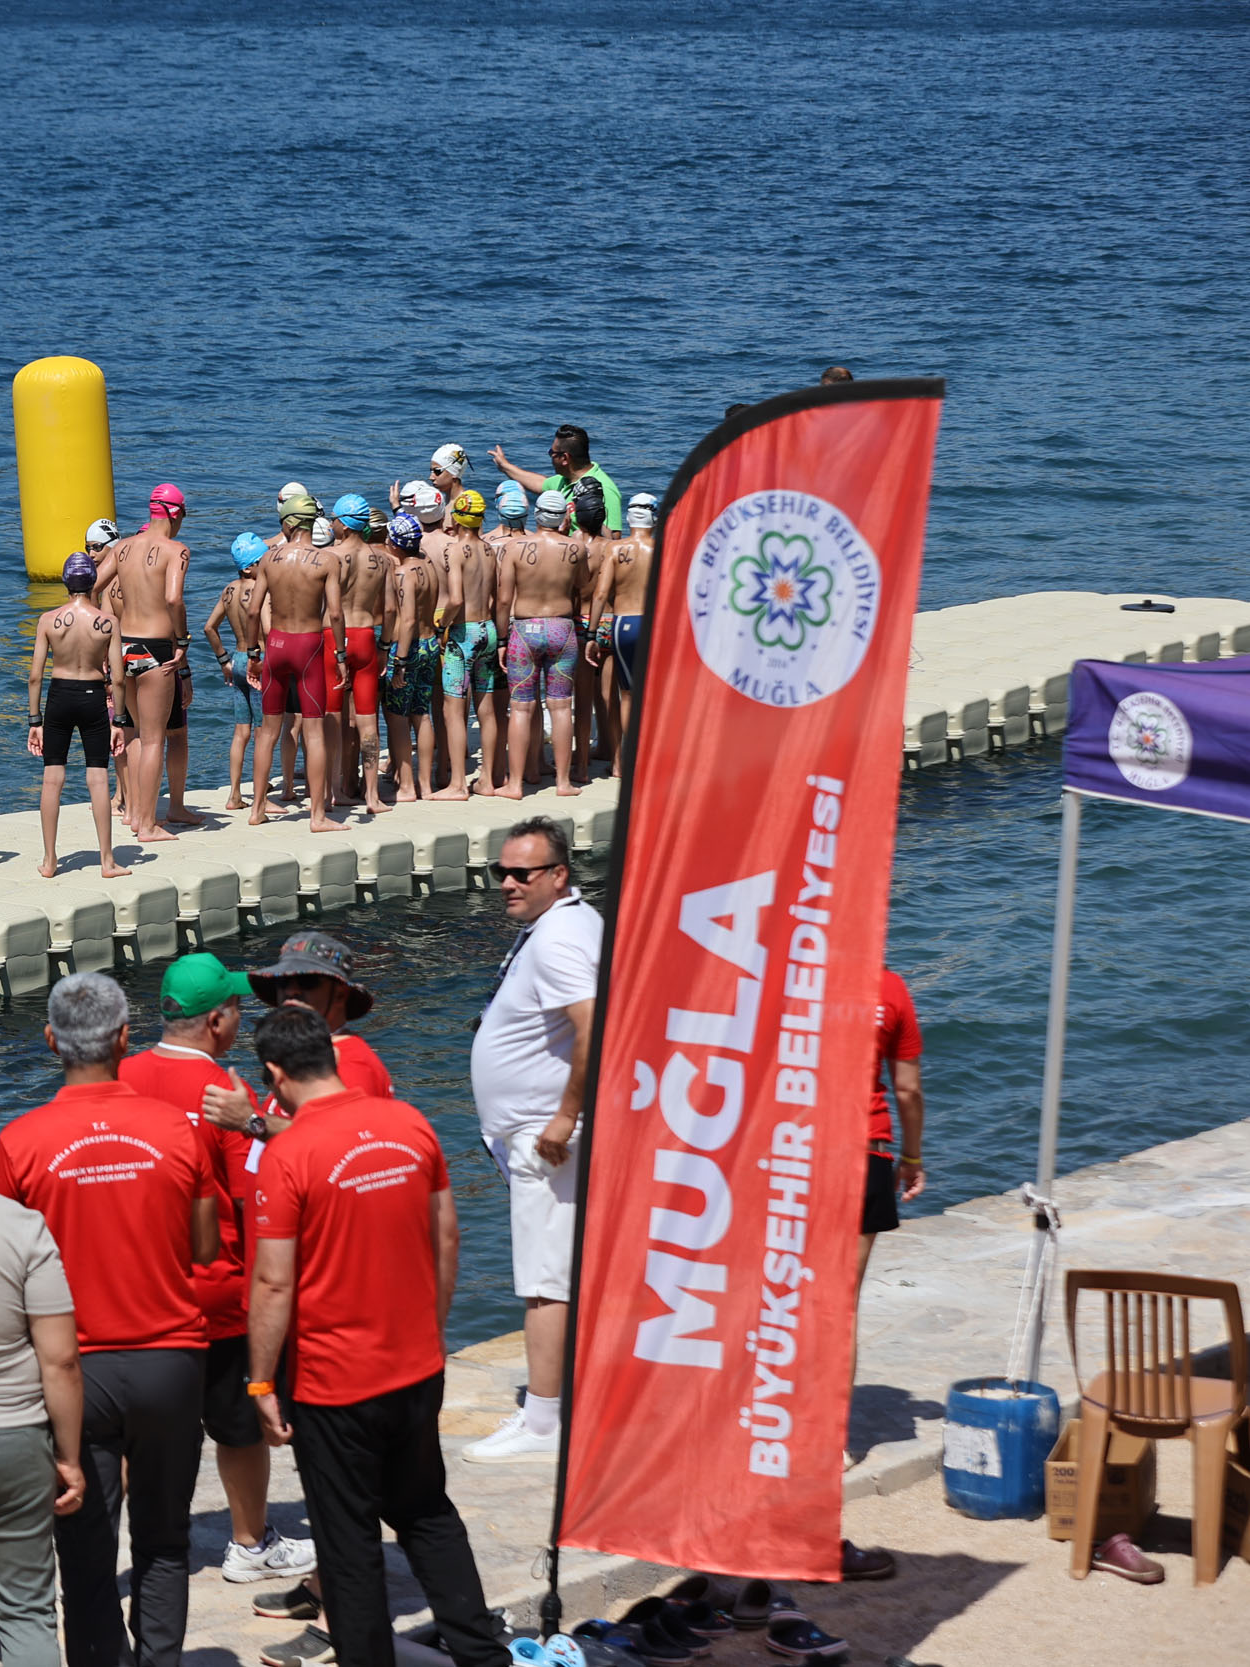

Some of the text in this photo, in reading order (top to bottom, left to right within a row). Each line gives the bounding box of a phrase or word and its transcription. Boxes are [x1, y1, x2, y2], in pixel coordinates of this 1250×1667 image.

[118, 544, 160, 566] 61 61
[517, 541, 579, 565] 78 78
[54, 611, 113, 634] 60 60
[728, 667, 823, 706] MUĞLA
[630, 870, 776, 1370] MUĞLA
[739, 775, 845, 1478] BÜYÜKŞEHİR BELEDİYESİ
